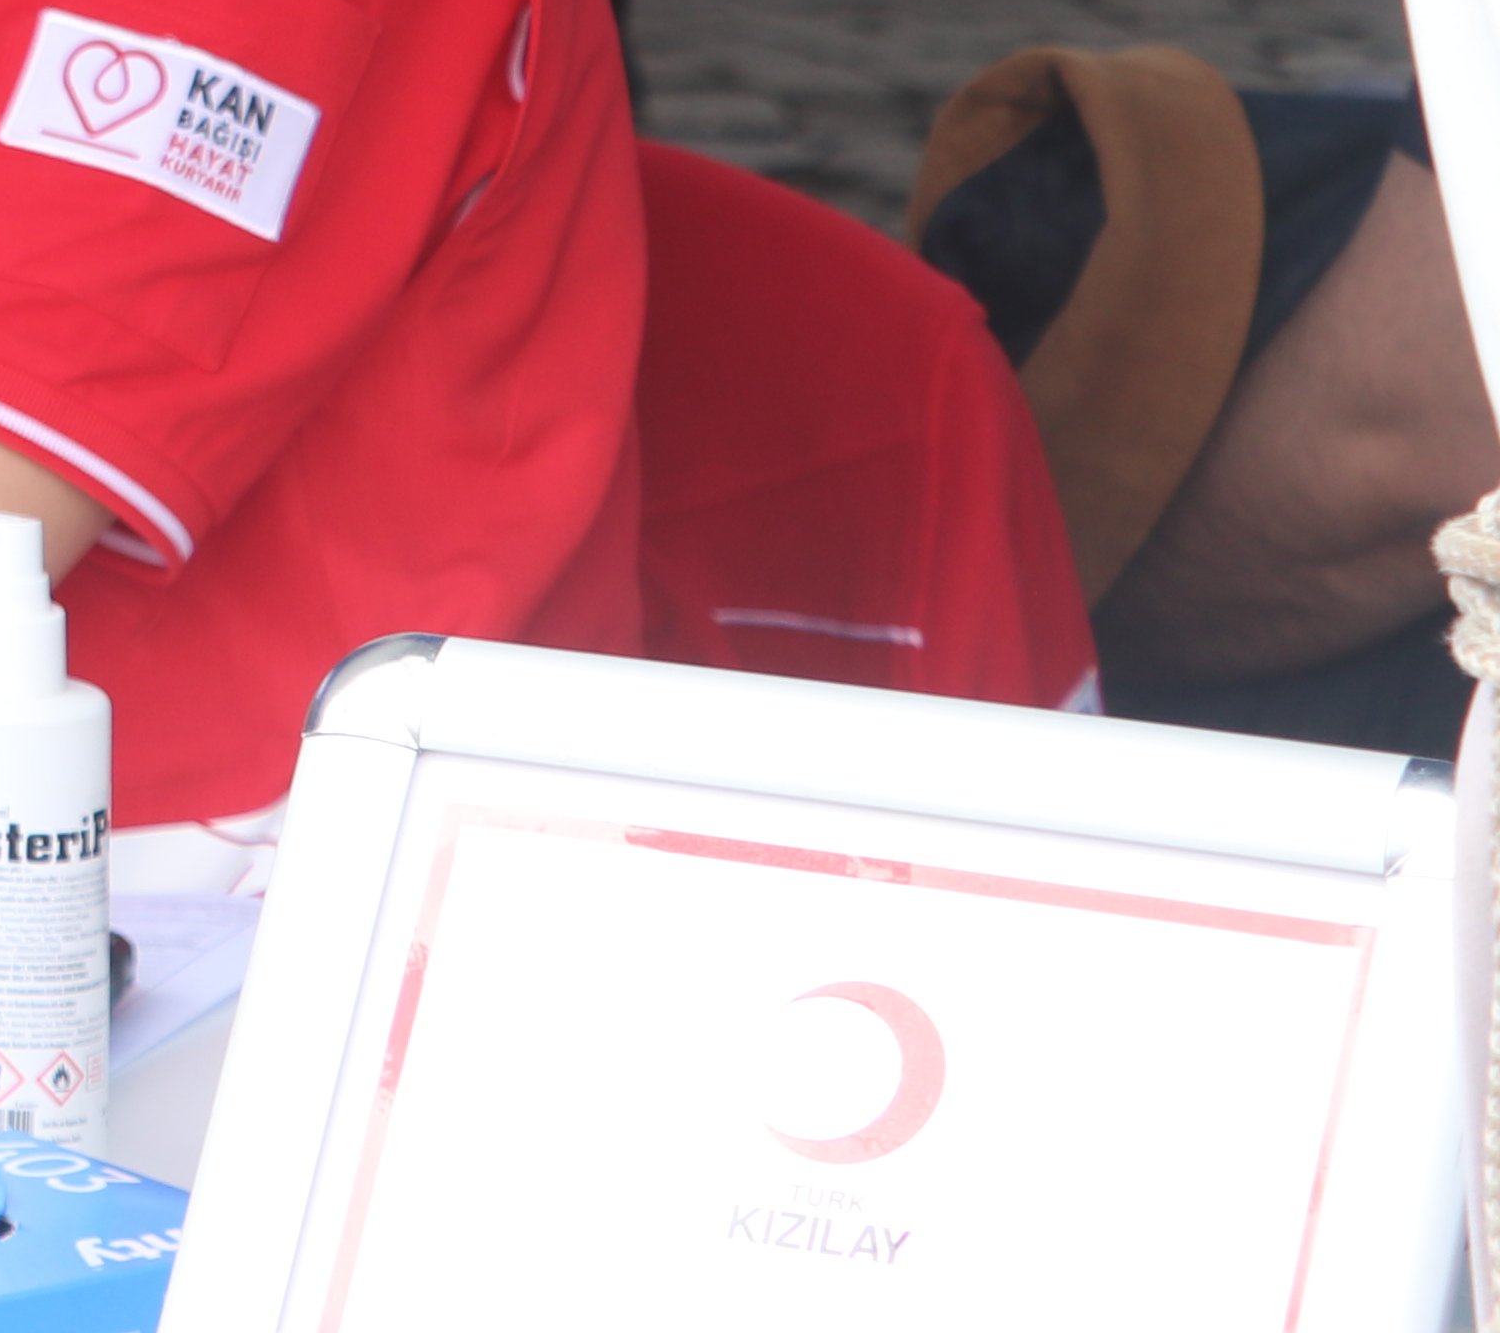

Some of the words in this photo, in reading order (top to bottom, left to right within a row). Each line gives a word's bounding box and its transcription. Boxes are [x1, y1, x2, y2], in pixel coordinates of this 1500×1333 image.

[188, 69, 276, 136] KAN
[168, 133, 253, 184] HAYAT
[177, 108, 262, 164] BAĞIŞI
[160, 155, 243, 204] KURTARIR
[75, 1228, 182, 1268] nty
[727, 1204, 911, 1265] KIZILAY
